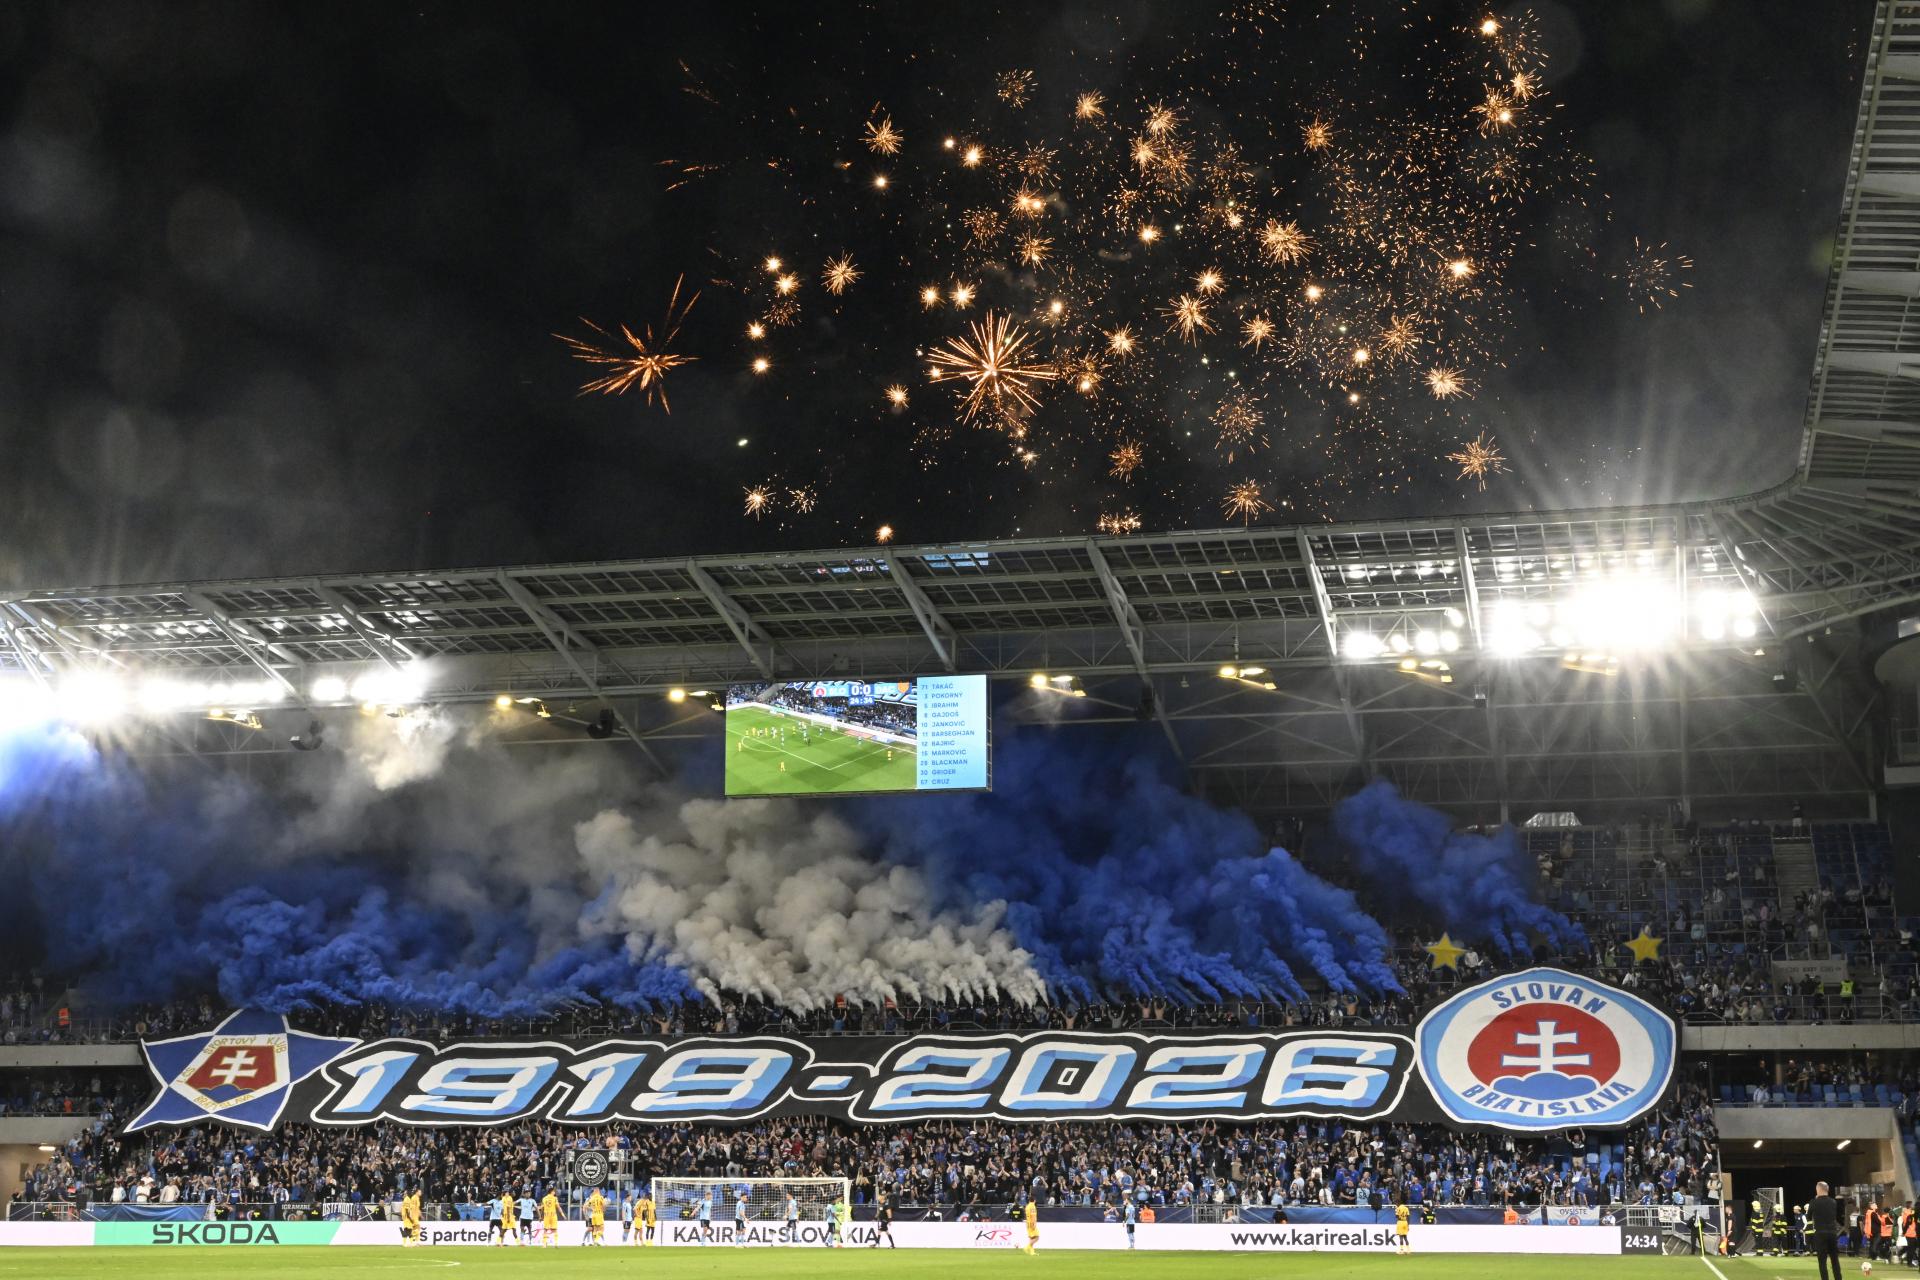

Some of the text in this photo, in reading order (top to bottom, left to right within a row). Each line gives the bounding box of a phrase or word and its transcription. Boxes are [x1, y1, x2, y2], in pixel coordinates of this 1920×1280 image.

[851, 685, 871, 695] 0:0
[849, 697, 874, 705] 24:34
[1491, 982, 1608, 1015] SLOVAN
[331, 1038, 1398, 1116] 1919-2026
[1461, 1080, 1637, 1117] BRATISLAVA
[674, 1226, 774, 1243] KARIRAL
[1230, 1228, 1397, 1246] www.karireal.sk
[1625, 1235, 1658, 1248] 24:34
